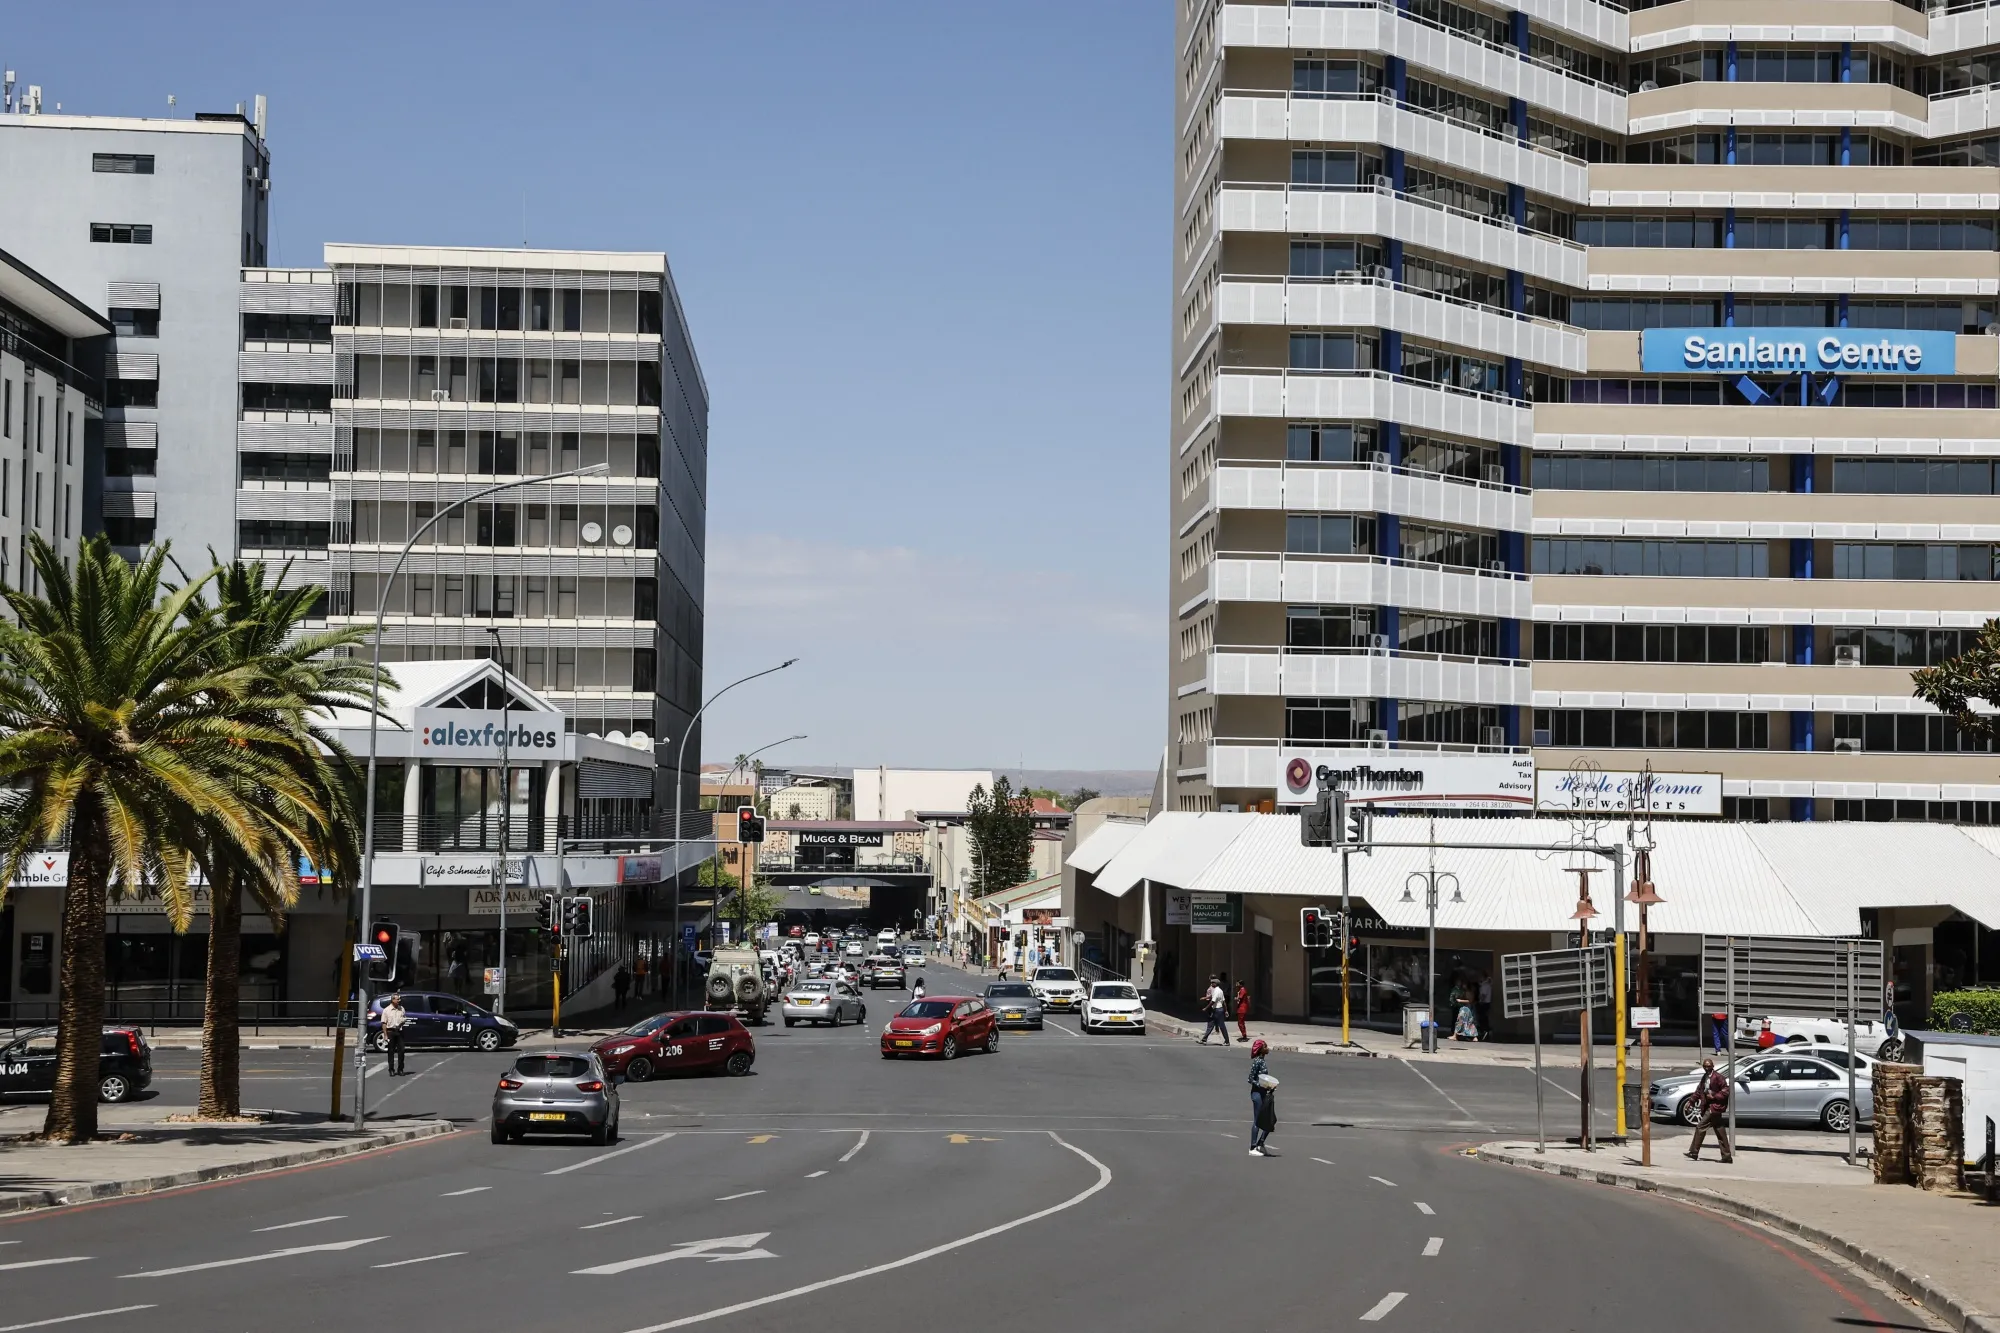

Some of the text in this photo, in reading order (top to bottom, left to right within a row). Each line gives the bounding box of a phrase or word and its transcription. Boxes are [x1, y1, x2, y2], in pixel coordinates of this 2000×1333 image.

[1683, 336, 1922, 365] Sanlam Centre
[1512, 760, 1533, 768] Audit
[1316, 764, 1424, 782] Grant Thornton
[1518, 771, 1532, 779] Tax
[1499, 782, 1532, 791] Advisory
[802, 834, 880, 844] MUGG & BEAN
[426, 864, 491, 878] Cafe Schneider
[357, 946, 382, 954] VOTE
[447, 1022, 472, 1033] B 119
[658, 1045, 683, 1058] J 206
